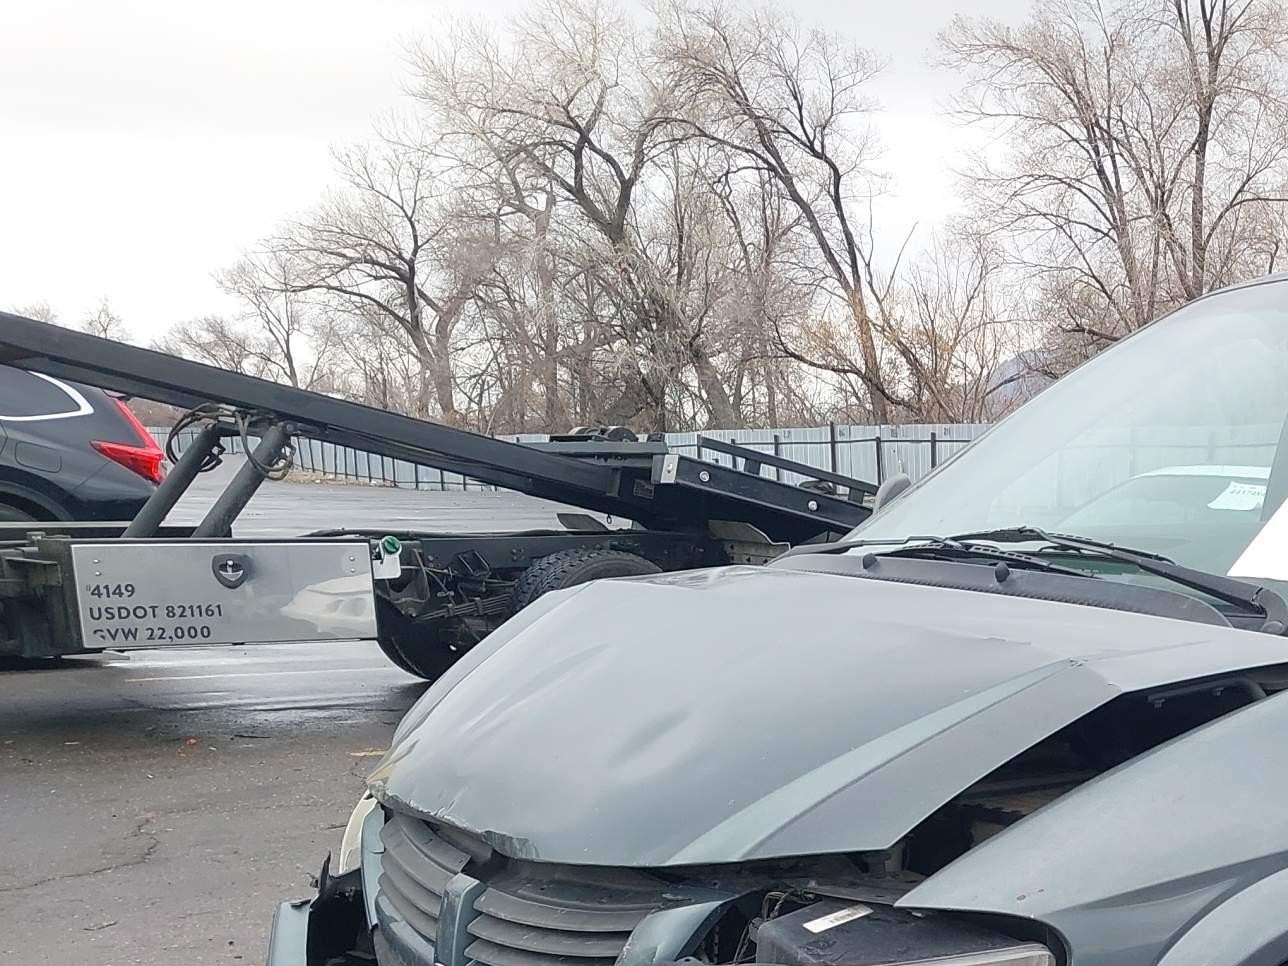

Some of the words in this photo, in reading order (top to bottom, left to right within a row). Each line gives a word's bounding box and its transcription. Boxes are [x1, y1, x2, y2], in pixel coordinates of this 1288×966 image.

[90, 584, 135, 598] 4149
[88, 605, 159, 621] USDOT
[165, 604, 224, 618] 821161
[145, 625, 212, 642] 22,000
